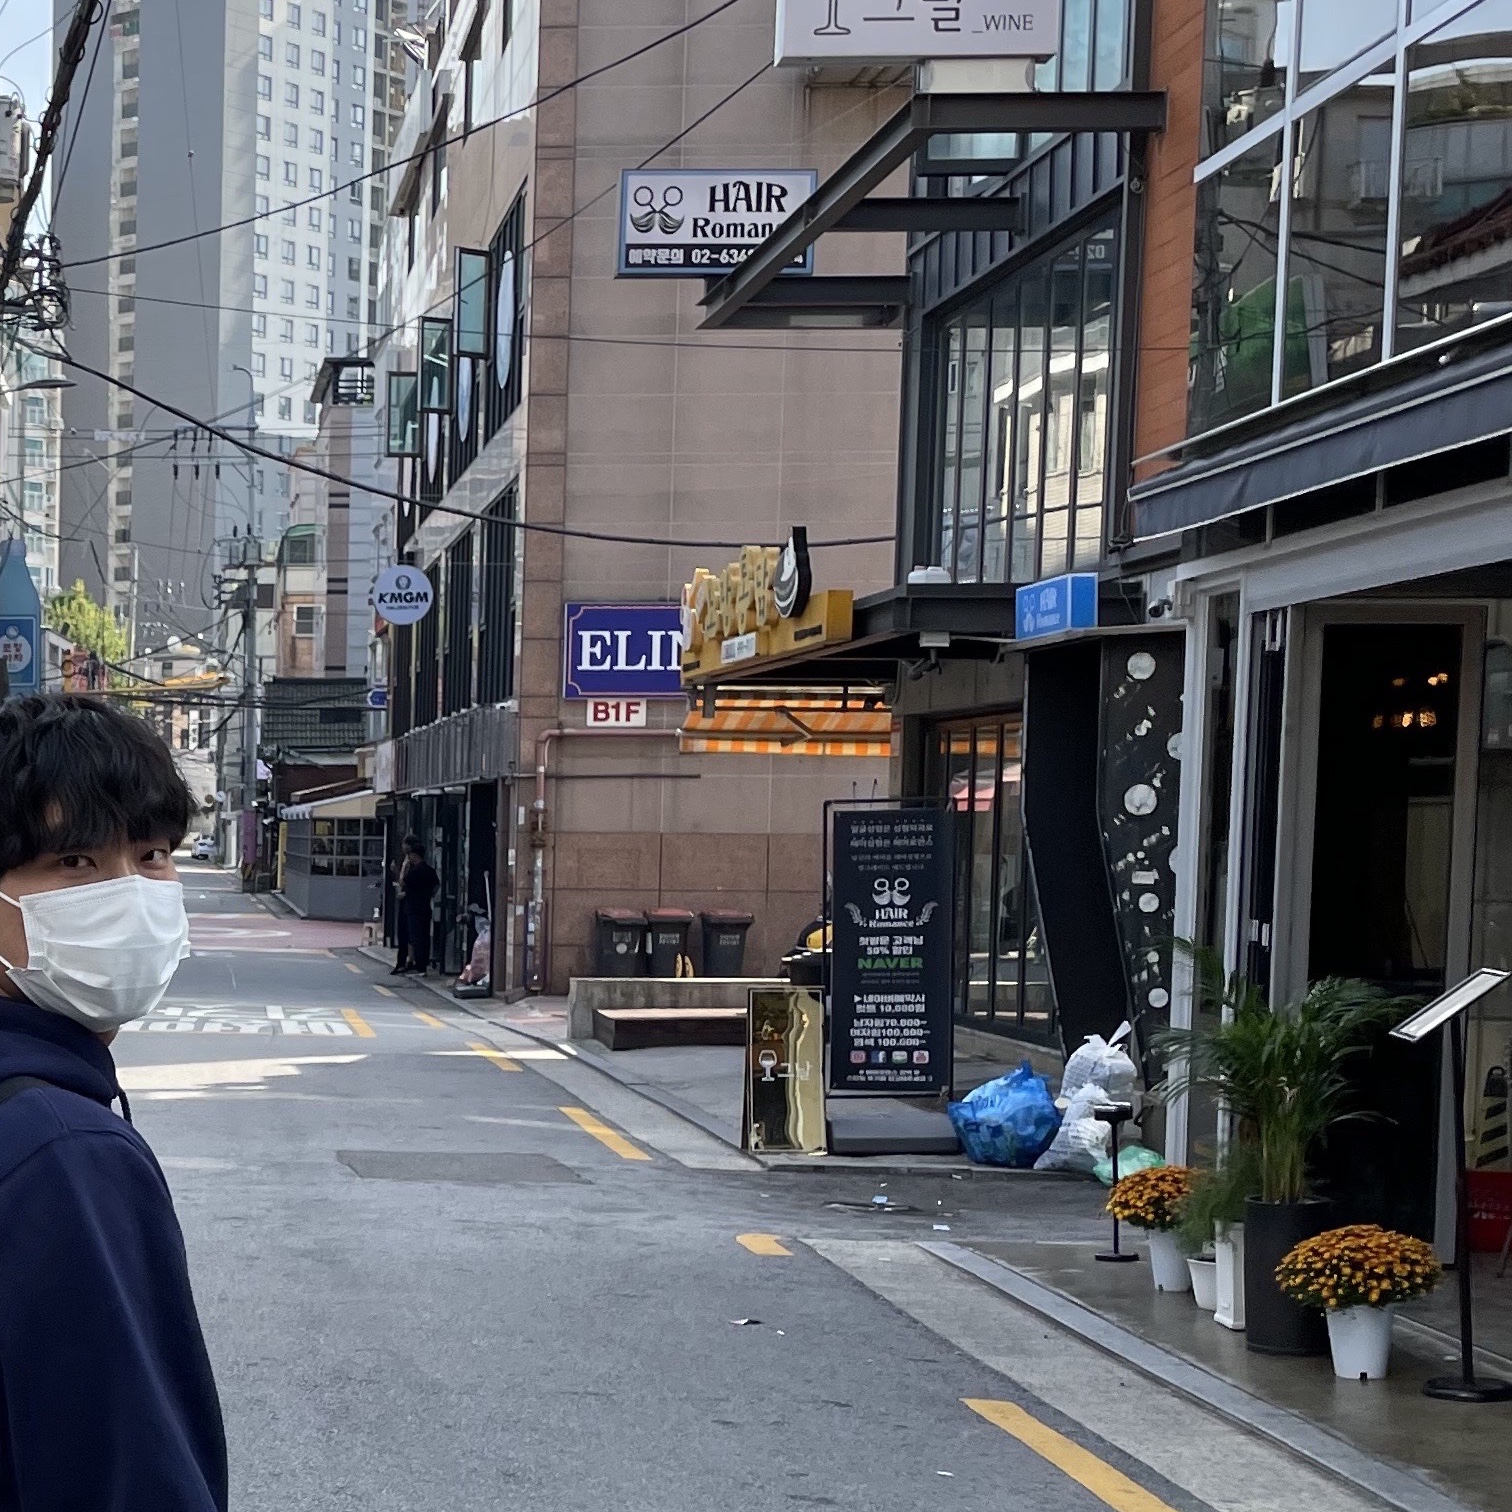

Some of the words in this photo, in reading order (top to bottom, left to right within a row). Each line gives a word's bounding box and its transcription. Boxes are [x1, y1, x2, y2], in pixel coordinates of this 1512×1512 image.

[707, 180, 788, 213] HAIR
[378, 591, 429, 604] KMGM
[593, 701, 642, 722] B1F
[875, 907, 908, 920] HAIR
[857, 957, 923, 969] NAVER
